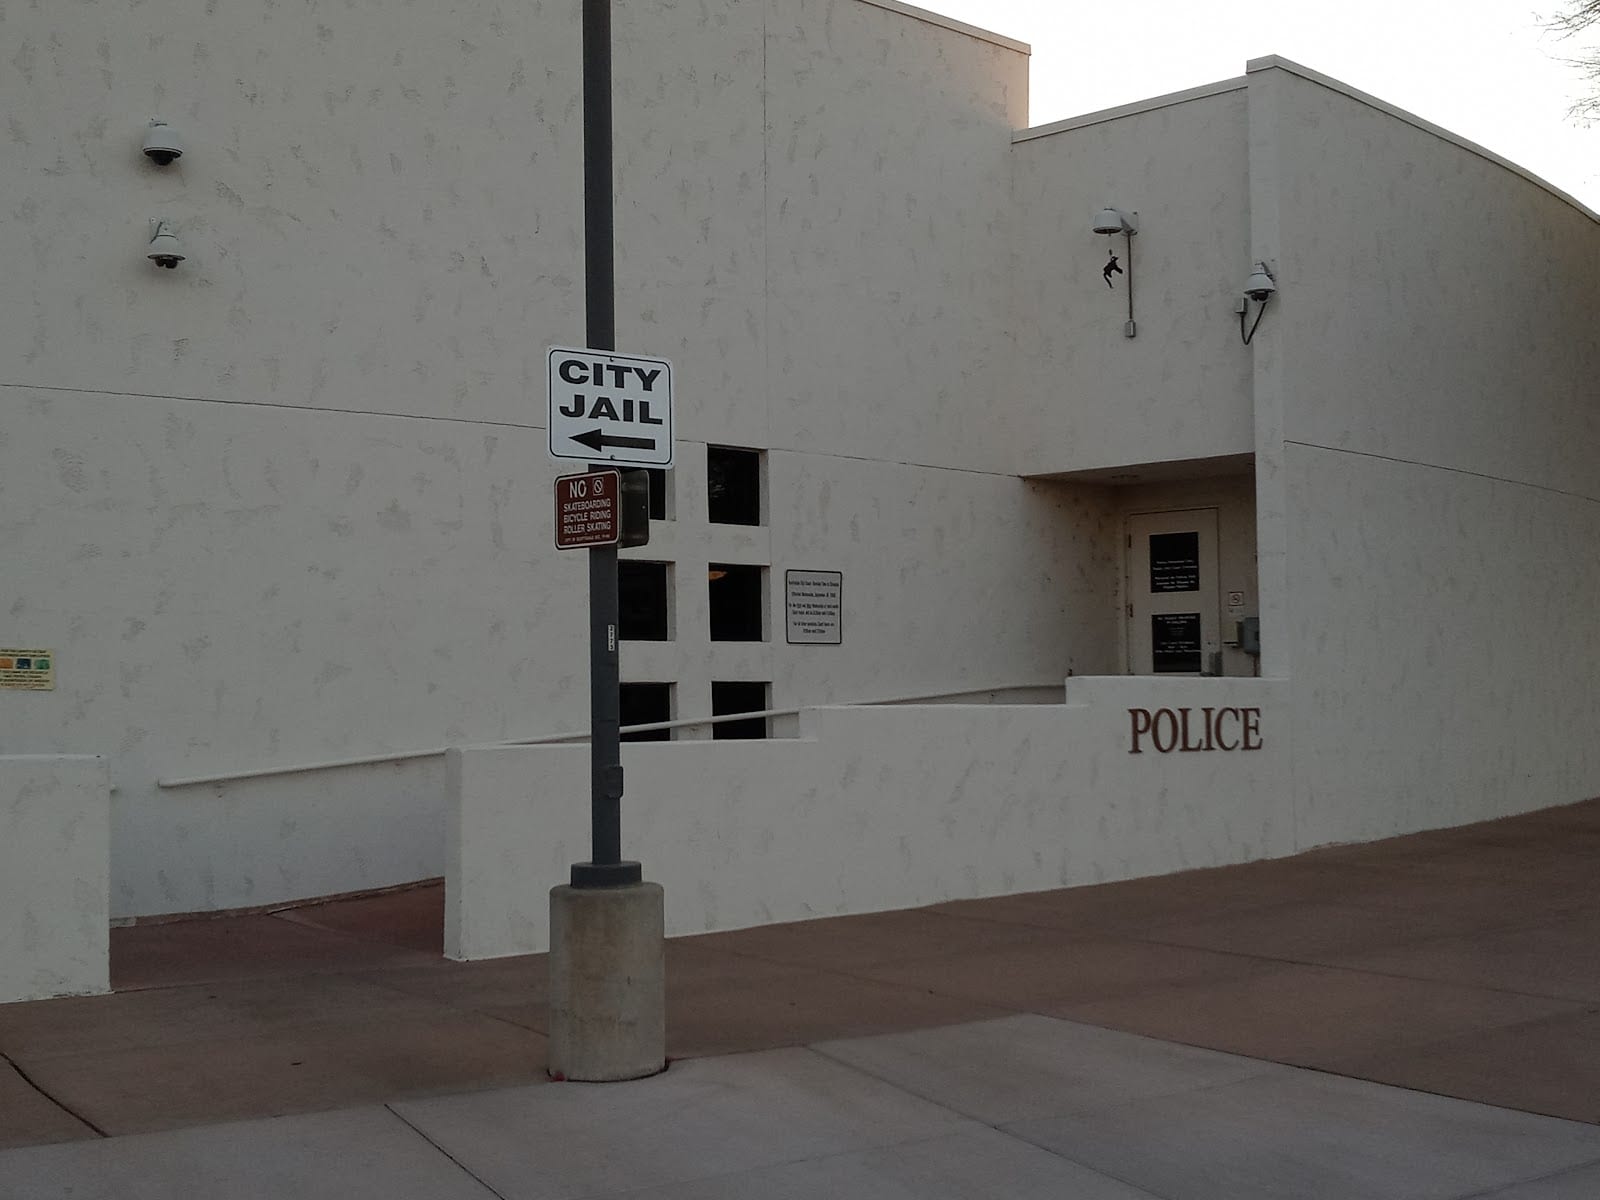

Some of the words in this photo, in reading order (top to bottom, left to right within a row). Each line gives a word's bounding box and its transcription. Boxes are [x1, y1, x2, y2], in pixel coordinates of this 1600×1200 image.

[559, 359, 661, 392] CITY
[559, 394, 663, 425] JAIL
[569, 479, 587, 499] NO
[563, 497, 611, 513] SKATEBOARDING
[563, 511, 589, 524] BICYCLE
[590, 509, 611, 521] RIDING
[563, 523, 586, 535] ROLLER
[586, 519, 611, 533] SKATING
[1128, 706, 1263, 754] POLICE
